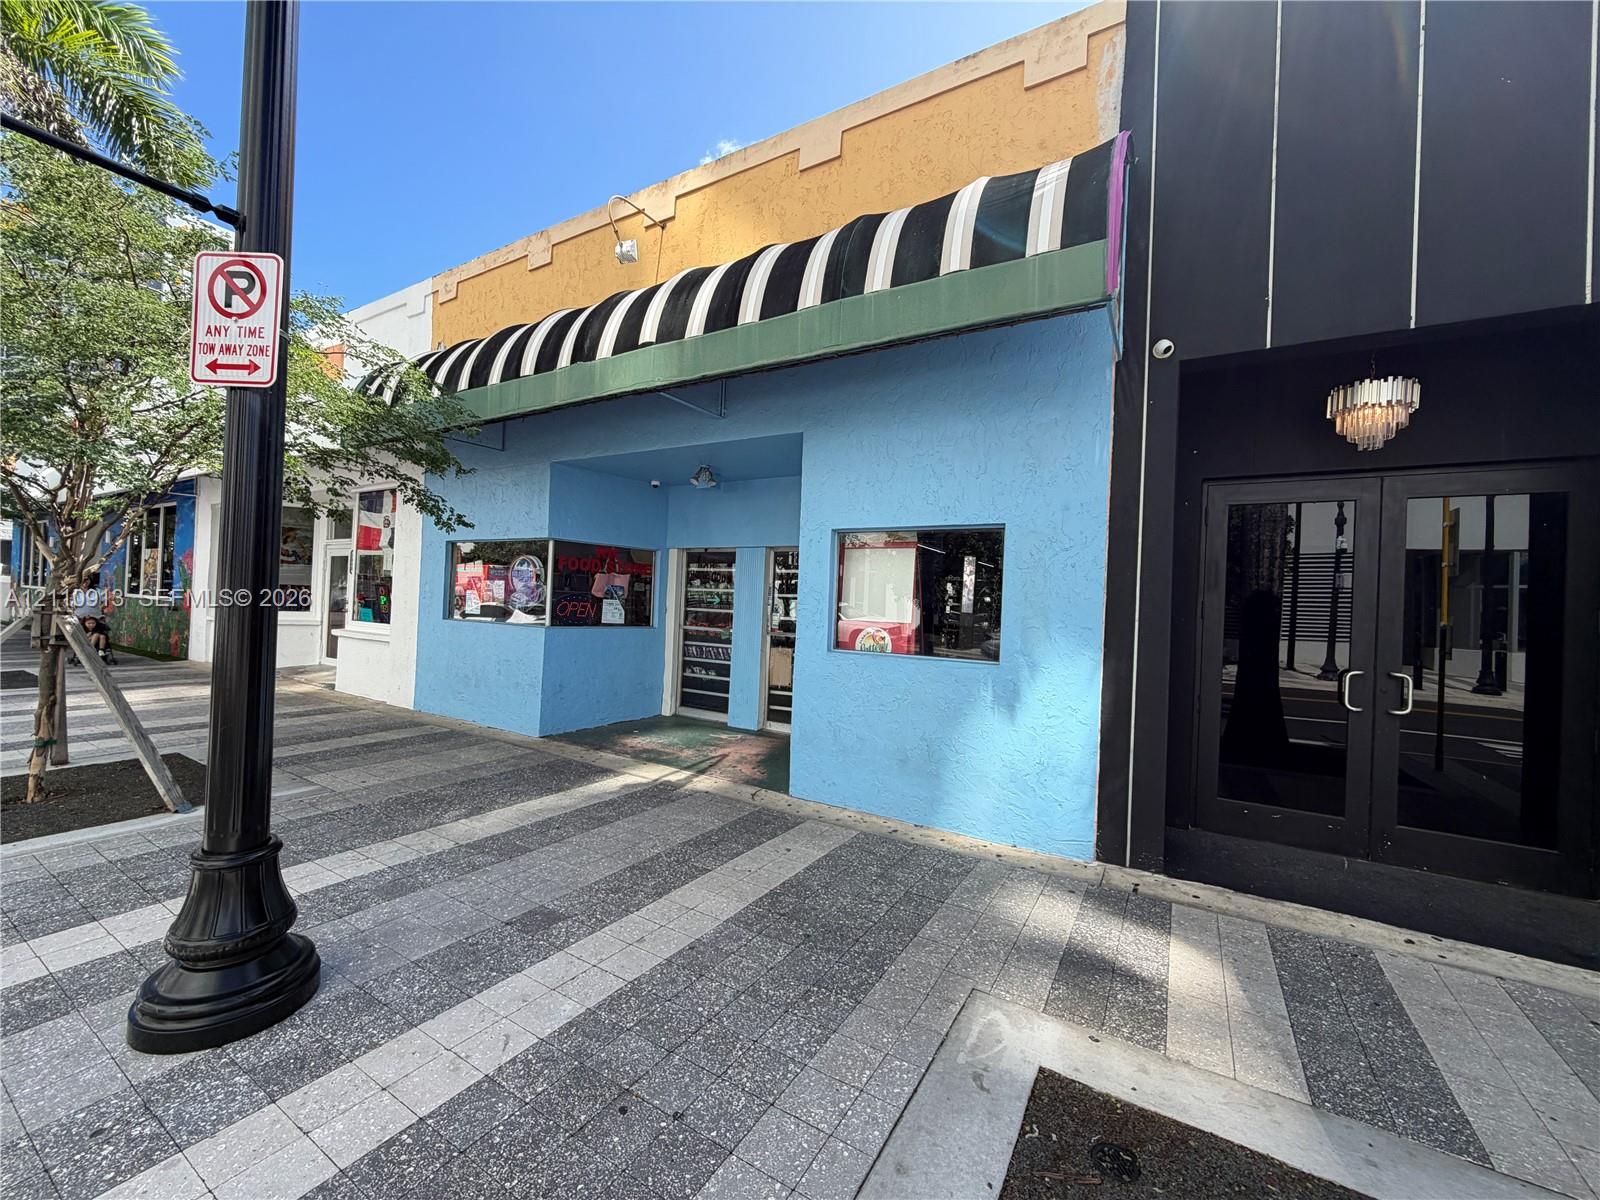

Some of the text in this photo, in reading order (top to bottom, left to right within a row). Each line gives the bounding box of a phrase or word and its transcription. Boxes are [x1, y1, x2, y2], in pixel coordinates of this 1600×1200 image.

[205, 325, 265, 339] ANY TIME
[198, 342, 270, 358] TOW AWAY ZONE
[557, 555, 601, 573] FOOD
[556, 601, 597, 618] OPEN
